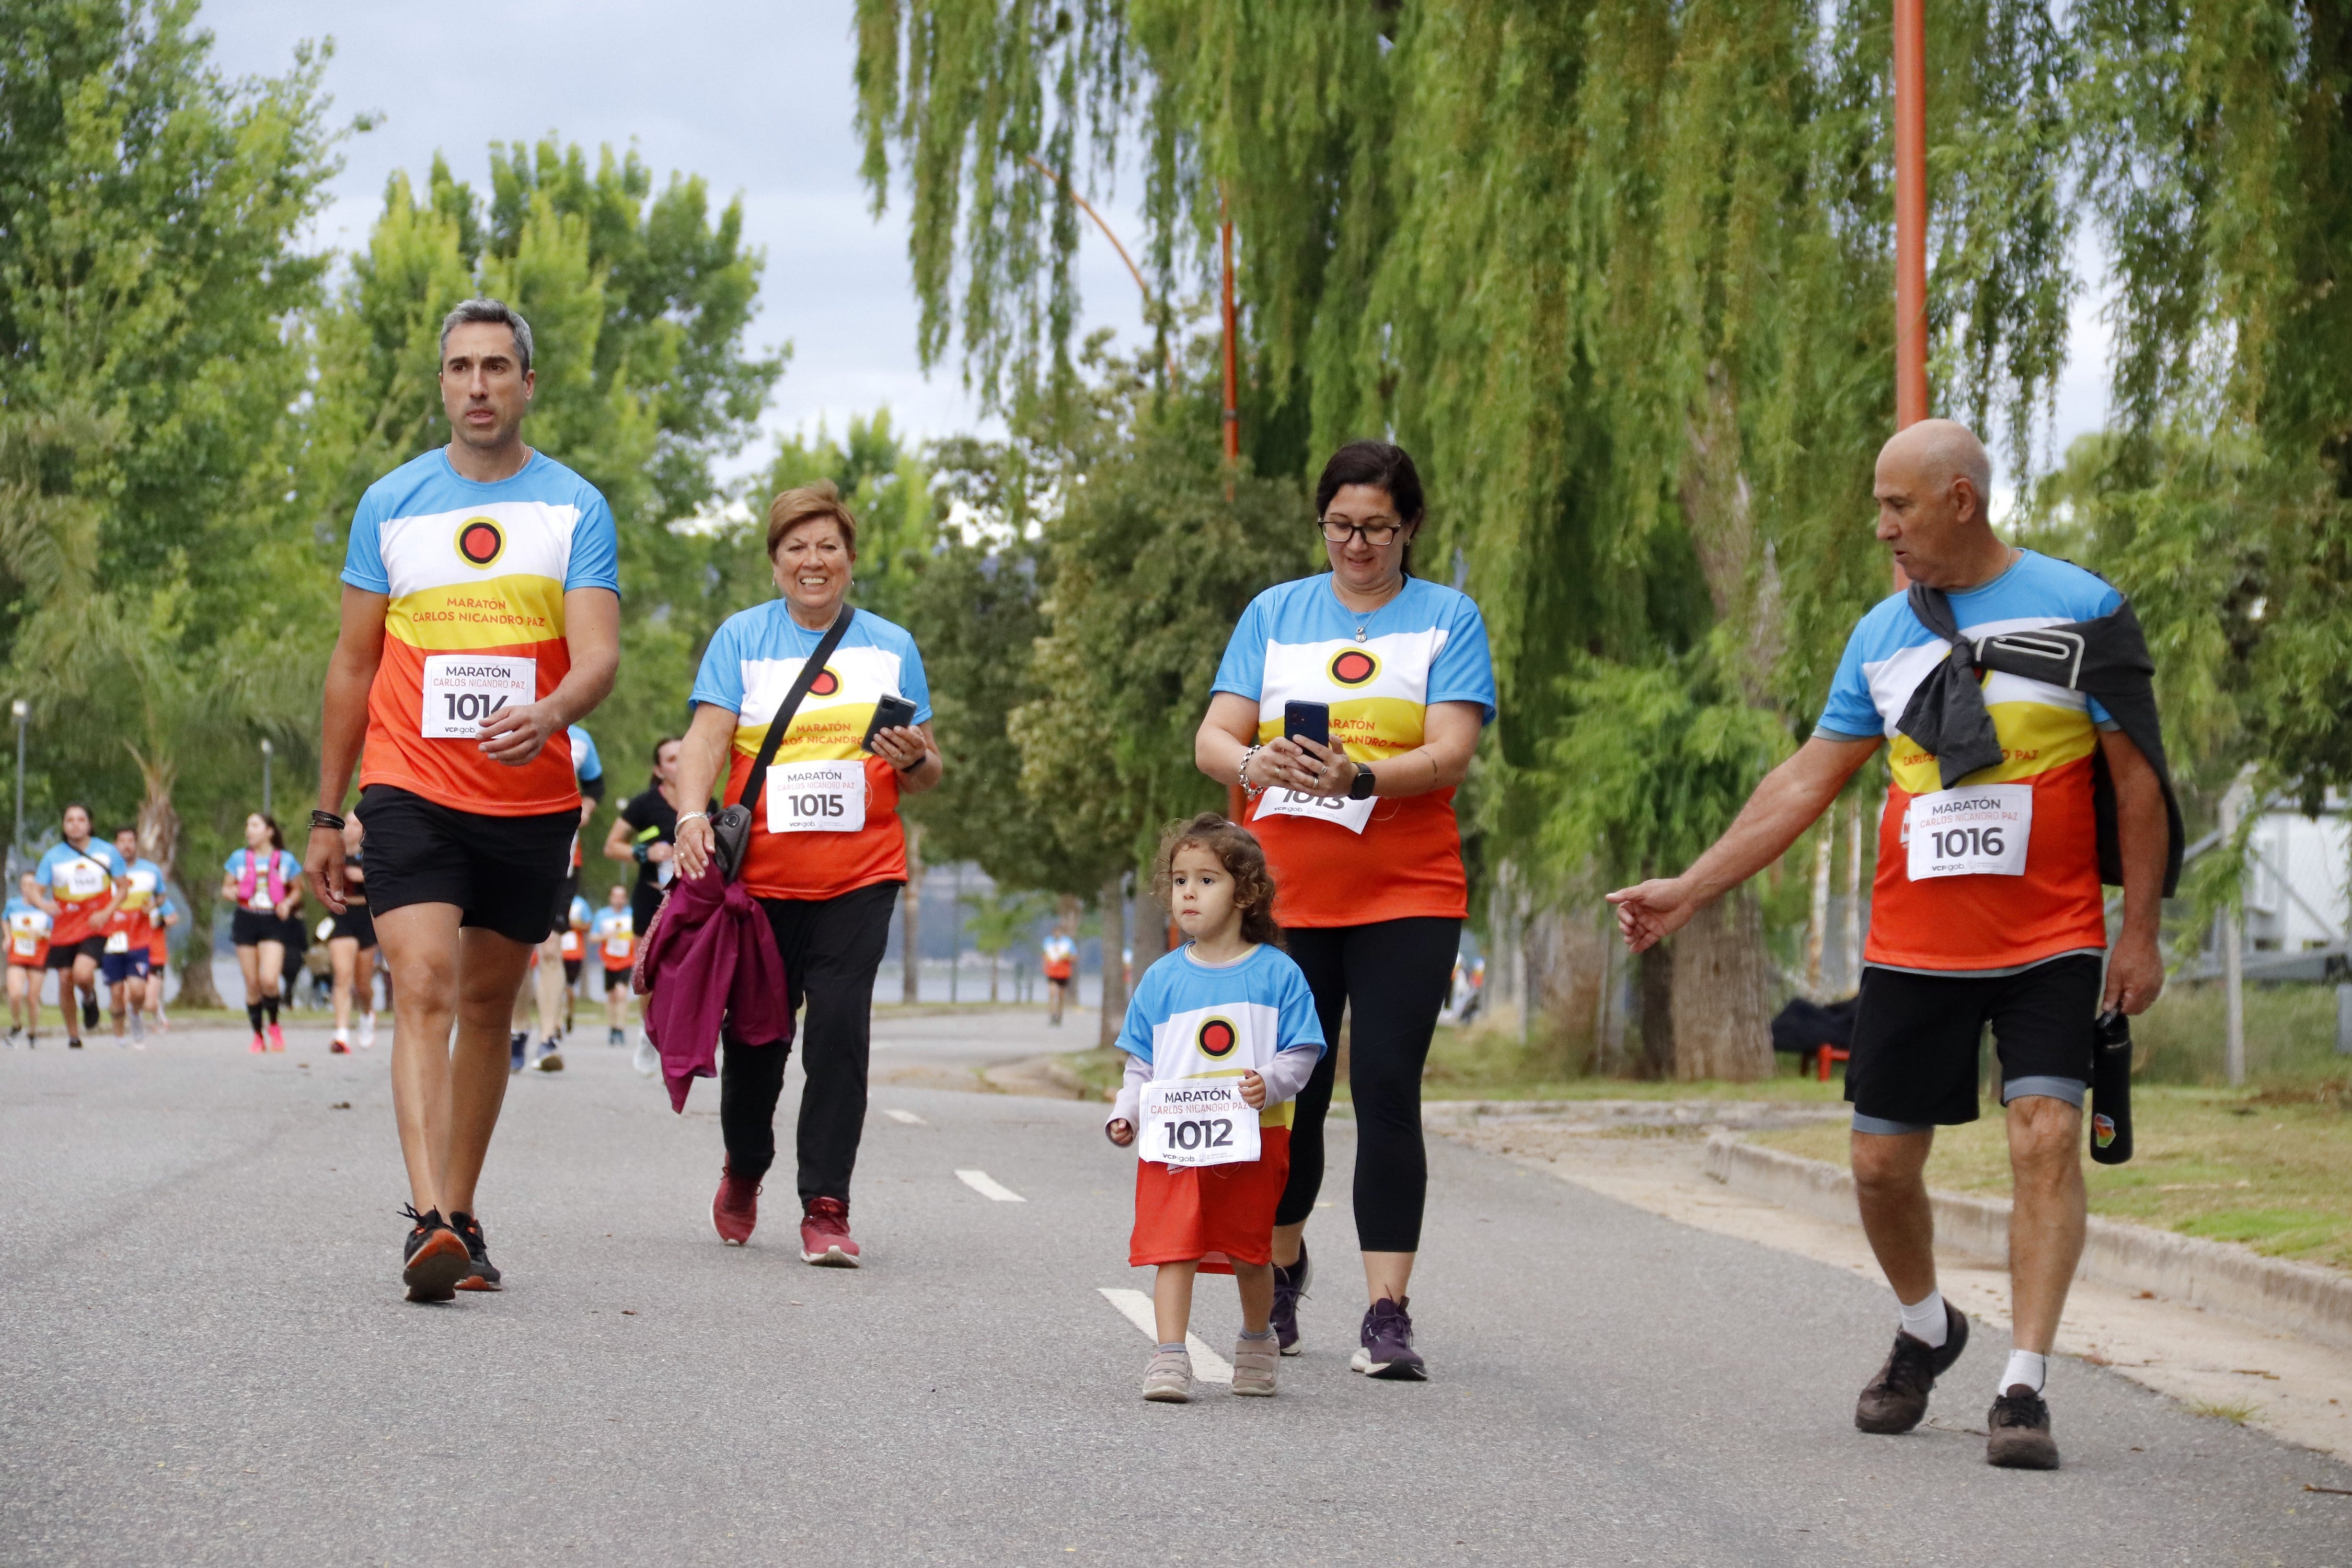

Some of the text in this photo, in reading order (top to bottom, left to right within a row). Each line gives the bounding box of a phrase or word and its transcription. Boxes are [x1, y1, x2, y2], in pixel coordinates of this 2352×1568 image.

[446, 597, 506, 610] MARATÓN
[413, 612, 545, 627] CARLOS NICANDRO PAZ
[446, 665, 511, 678] MARATÓN
[469, 680, 508, 688] NICANDRO
[511, 681, 525, 689] PAZ
[797, 720, 851, 733] MARATÓN
[1328, 717, 1375, 731] ARATÓN
[807, 736, 863, 745] NICANDRO
[1338, 734, 1388, 747] CANDRO
[1904, 753, 1935, 766] CARLOS
[2015, 749, 2039, 760] PAZ
[788, 770, 842, 782] MARATÓN
[777, 782, 805, 791] CARLOS
[788, 794, 844, 817] 1015
[1932, 797, 2001, 816] MARATÓN
[1920, 811, 2019, 828] CARLOS NICANDRO PAZ
[1932, 827, 2005, 858] 1016
[1165, 1088, 1231, 1103] MARATÓN
[1150, 1102, 1248, 1114] CARLOS NICANDRO PAZ
[1165, 1119, 1233, 1150] 1012
